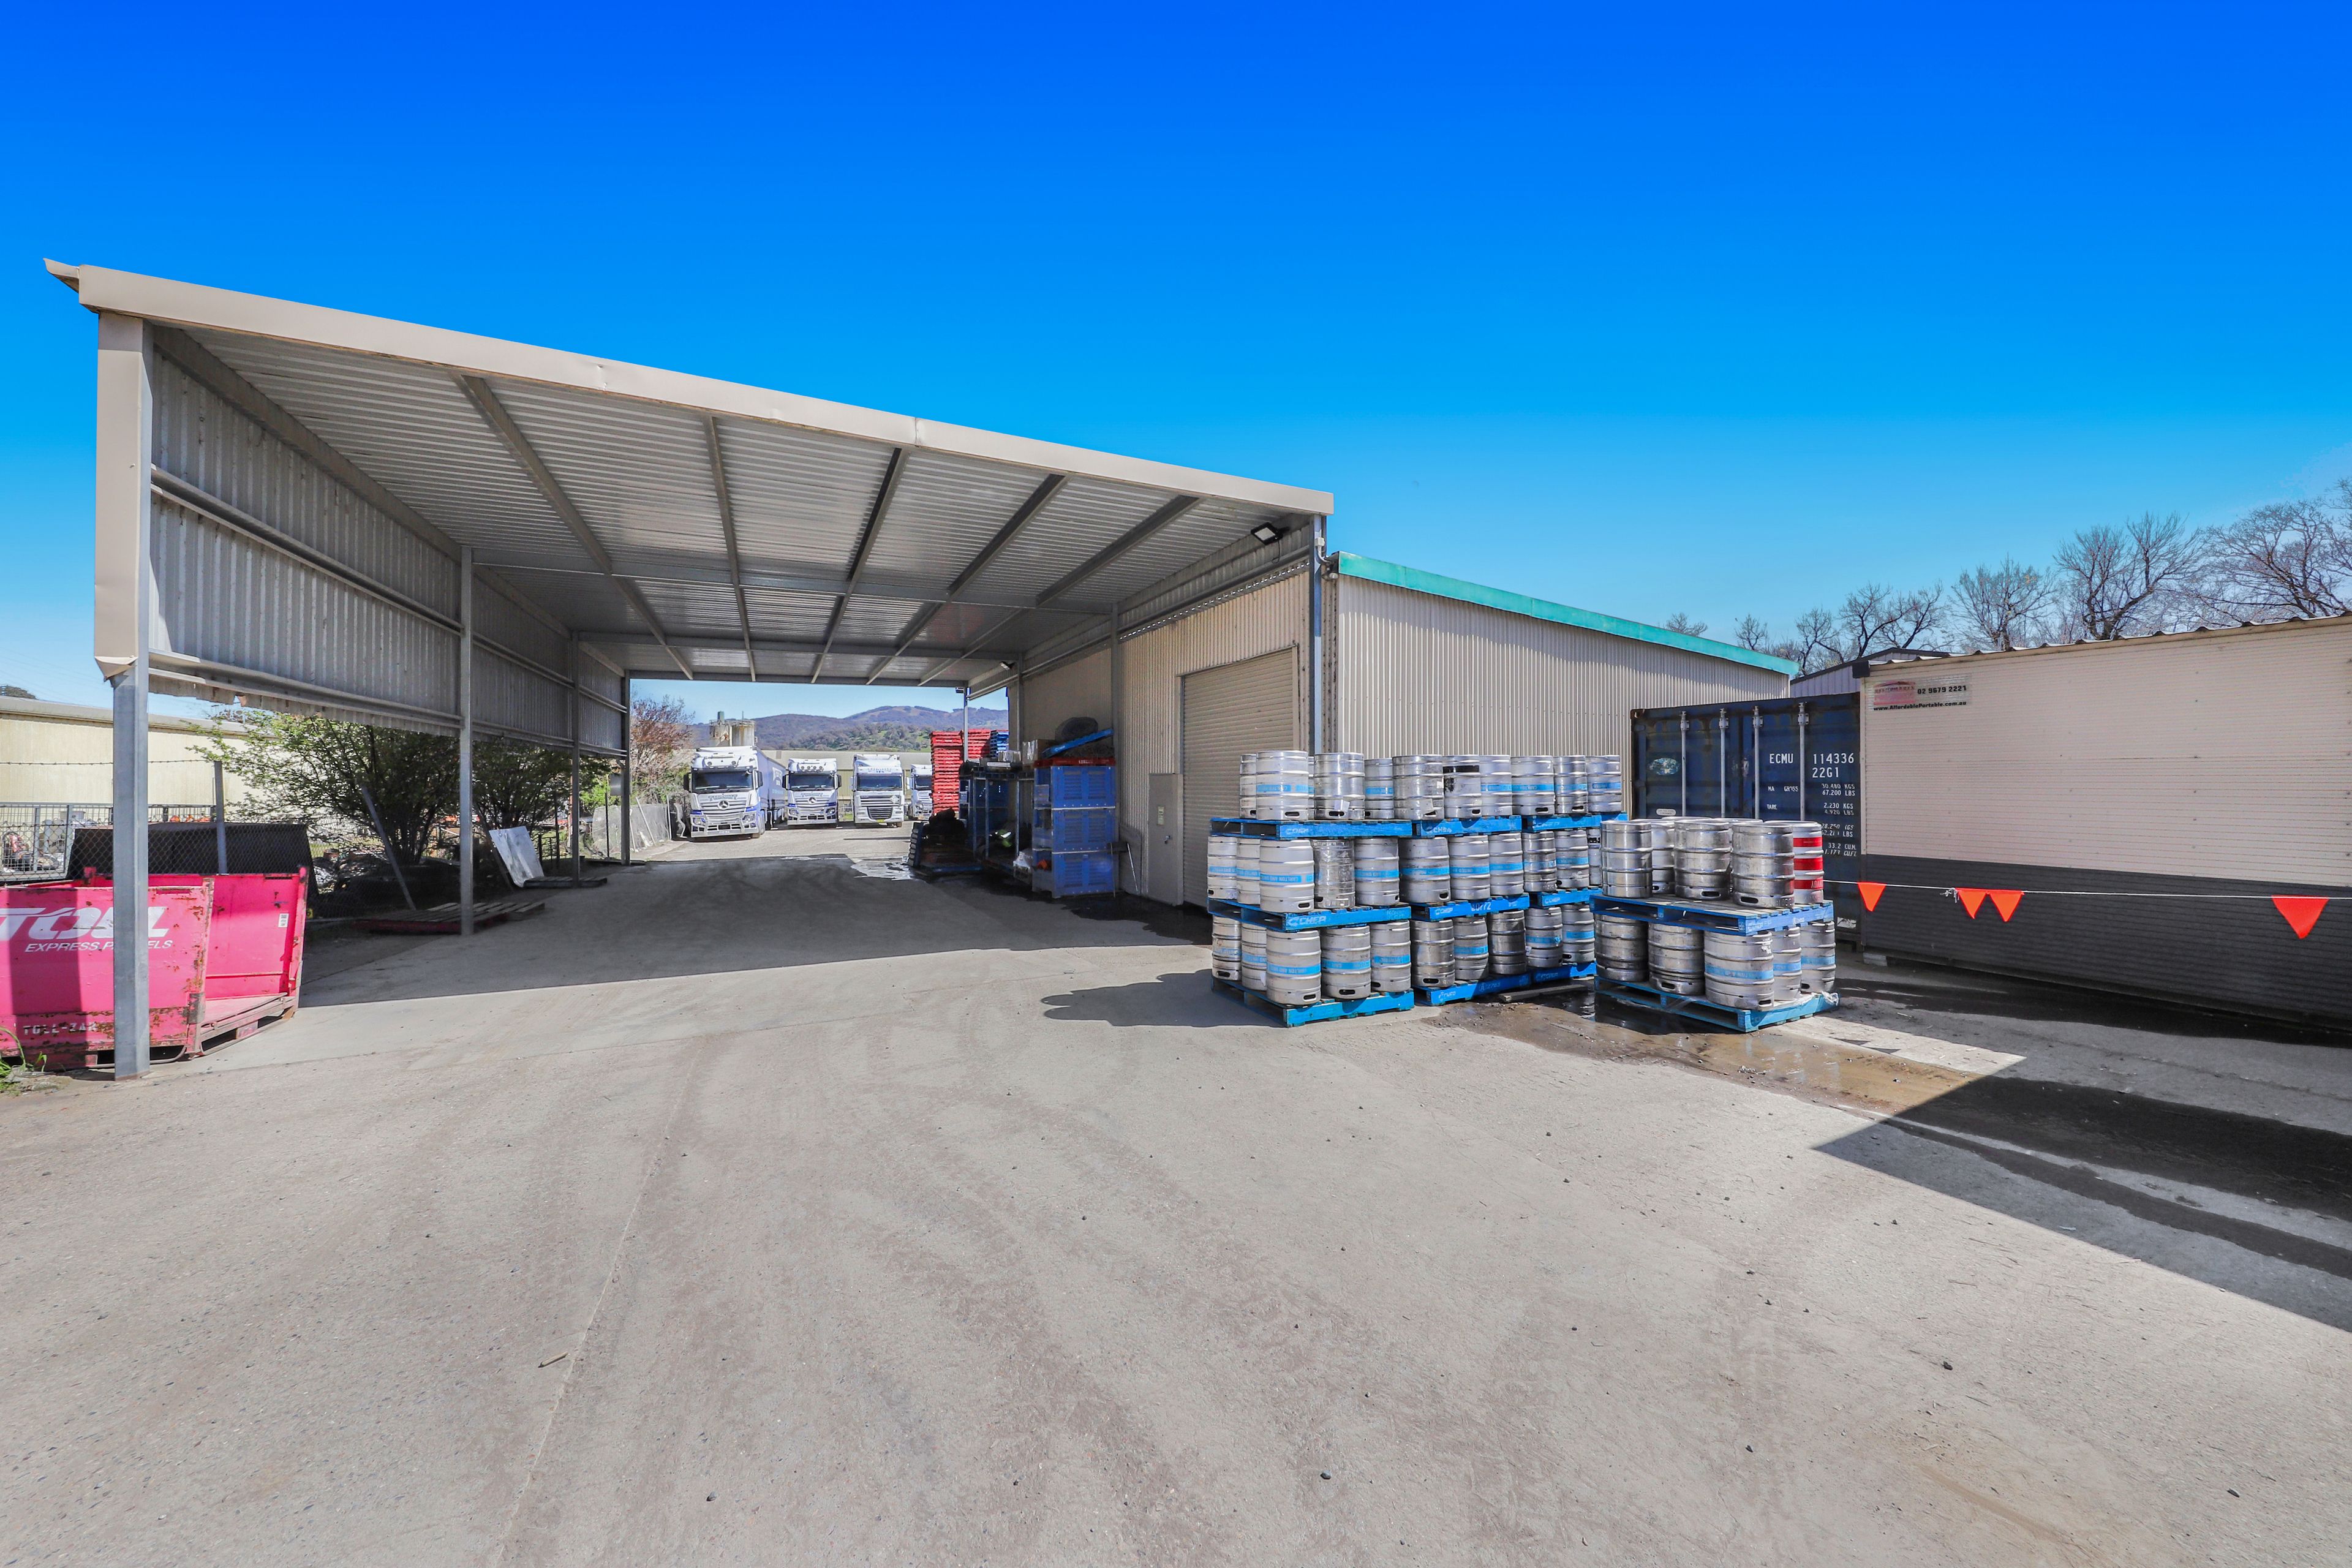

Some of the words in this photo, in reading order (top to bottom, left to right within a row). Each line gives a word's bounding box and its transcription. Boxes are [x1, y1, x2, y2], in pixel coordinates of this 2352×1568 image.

[1873, 701, 1967, 711] www.AffordablePortable.com.au
[1770, 753, 1793, 764] ECMU
[1813, 753, 1855, 764] 114336
[1812, 767, 1839, 778] 22G1
[0, 907, 169, 941] TOLL
[1299, 916, 1325, 925] CHEP
[25, 941, 99, 952] EXPRESS
[102, 940, 173, 951] PELS
